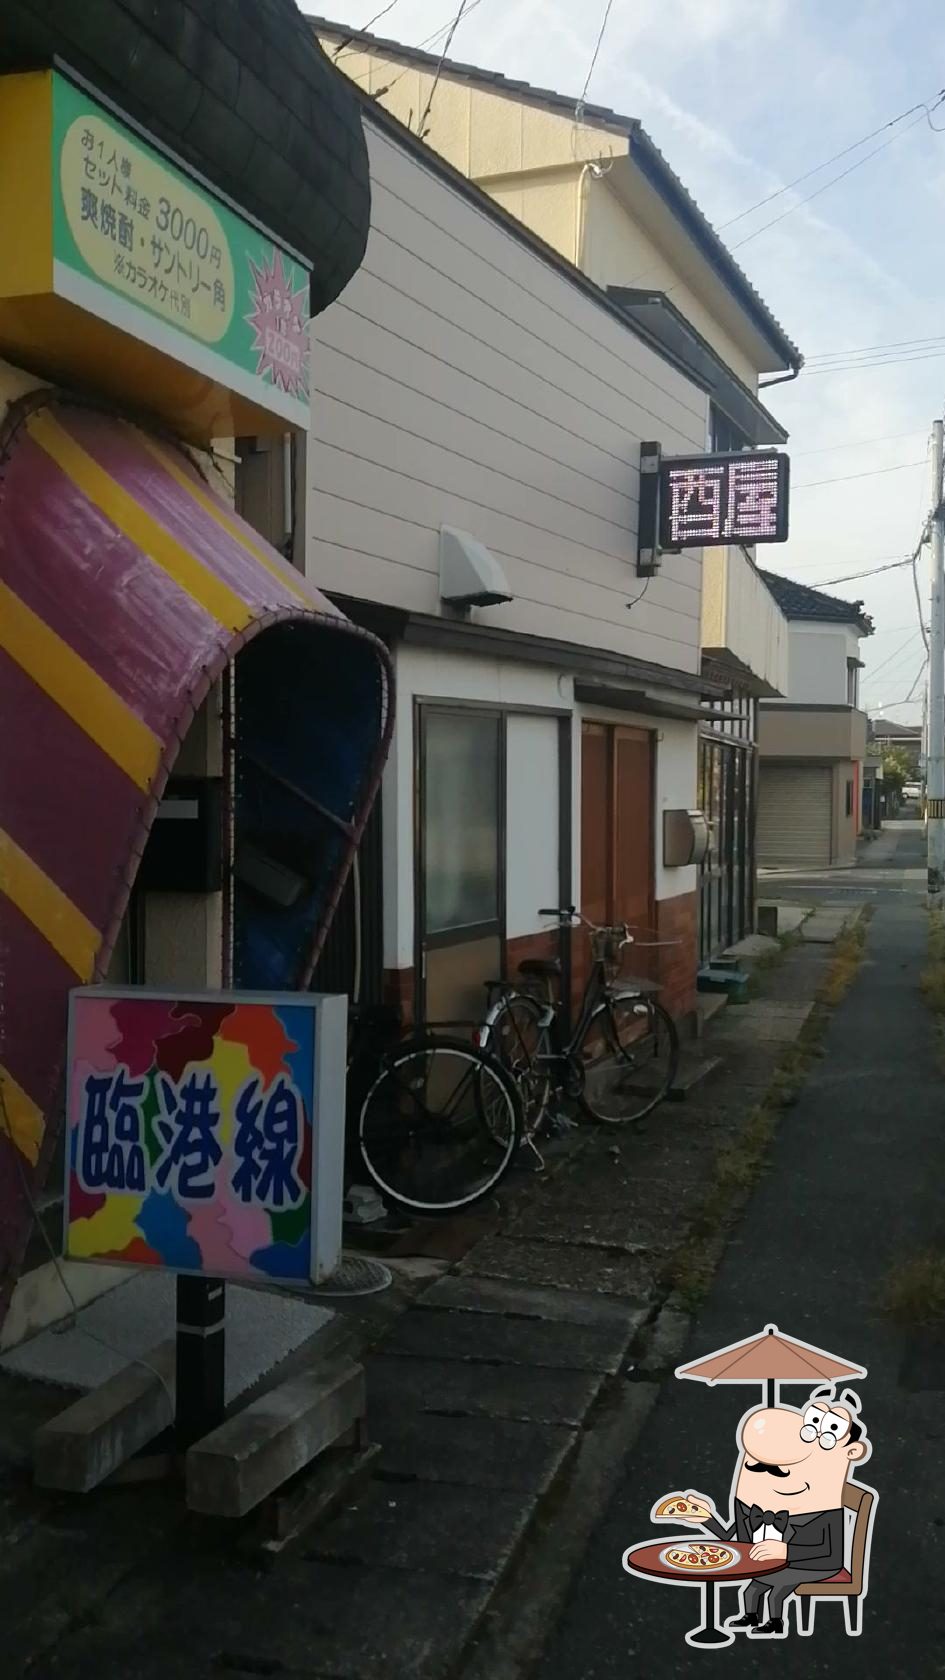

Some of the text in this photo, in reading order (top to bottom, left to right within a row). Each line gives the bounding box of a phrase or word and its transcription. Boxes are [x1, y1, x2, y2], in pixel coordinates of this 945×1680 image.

[155, 197, 222, 270] 3000円
[81, 1067, 303, 1207] 臨港線
